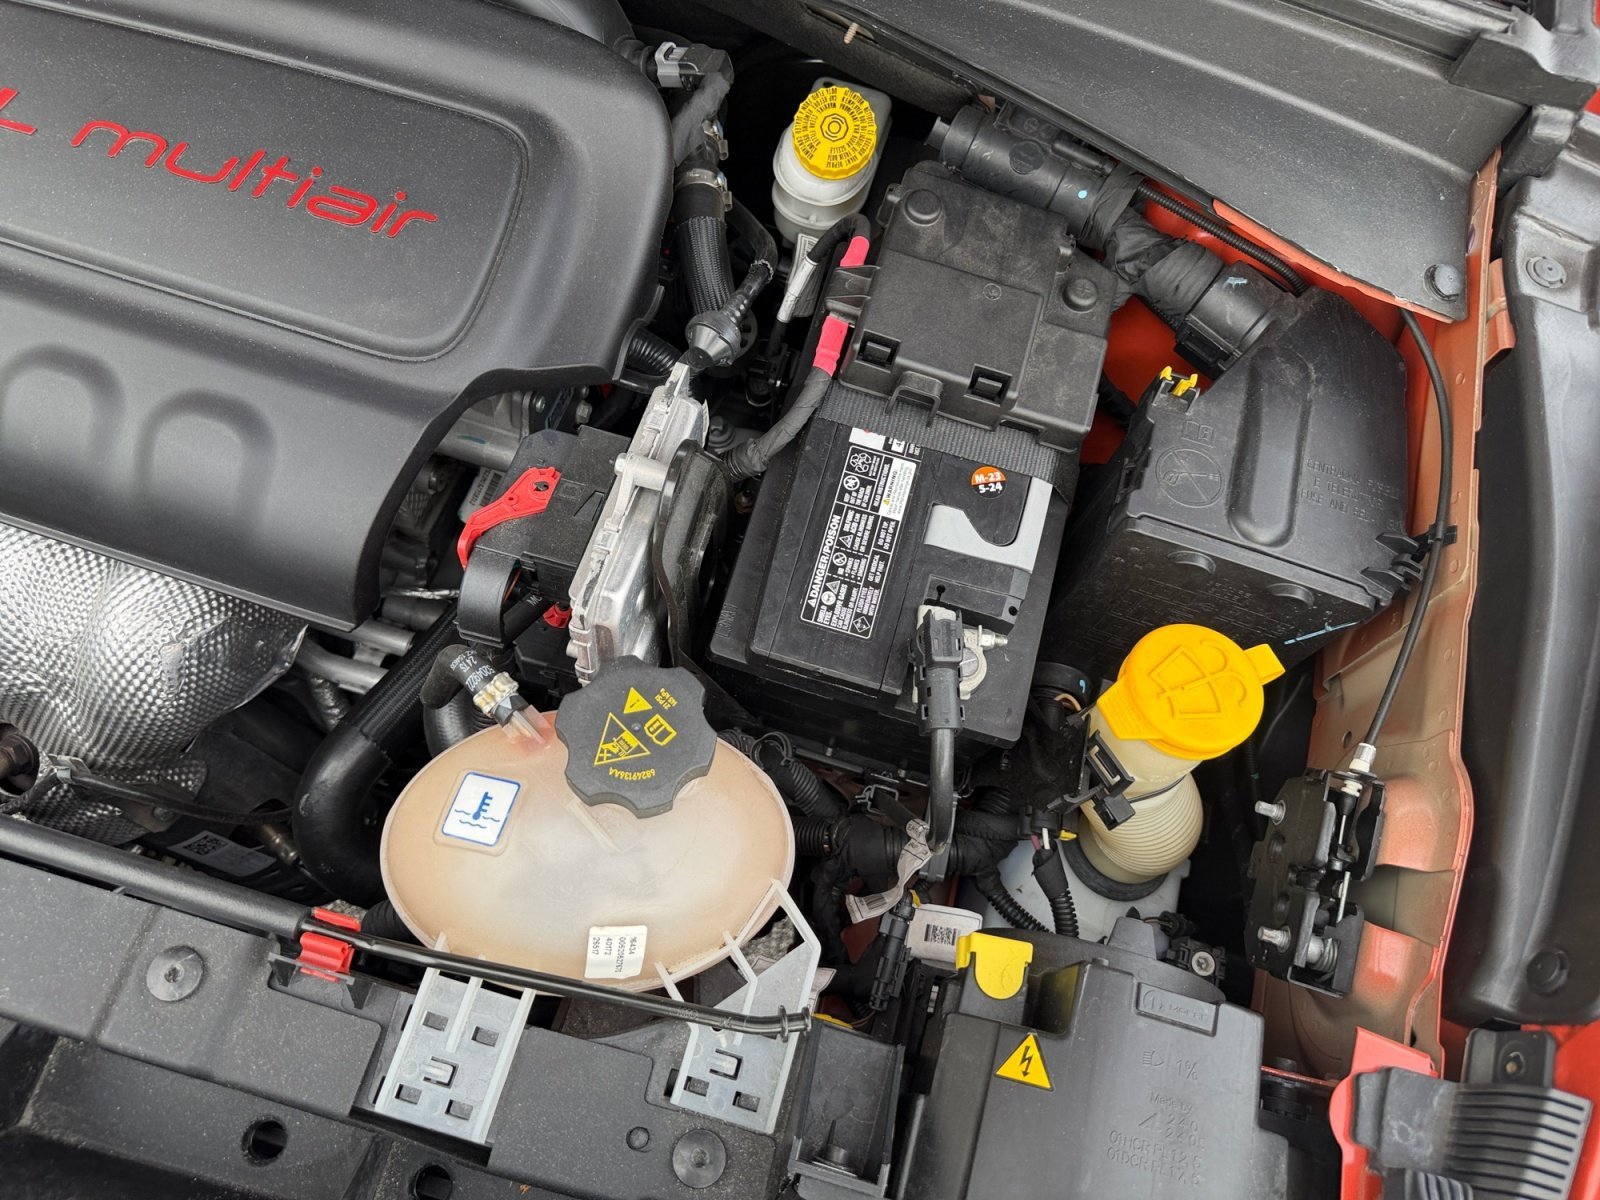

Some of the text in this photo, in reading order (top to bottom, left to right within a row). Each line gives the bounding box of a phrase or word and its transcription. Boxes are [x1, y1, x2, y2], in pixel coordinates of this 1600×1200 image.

[72, 120, 437, 239] multiair
[975, 471, 1001, 482] M-23
[978, 482, 1001, 493] 5-24
[873, 494, 881, 506] READ
[842, 509, 854, 532] SULFURIC
[809, 513, 841, 598] DANGER/POISON
[831, 583, 847, 626] EXPLOSIVE GASES
[817, 604, 827, 623] SHIELD
[458, 660, 470, 673] TS
[464, 654, 477, 667] 24
[609, 767, 655, 780] 68249136AA
